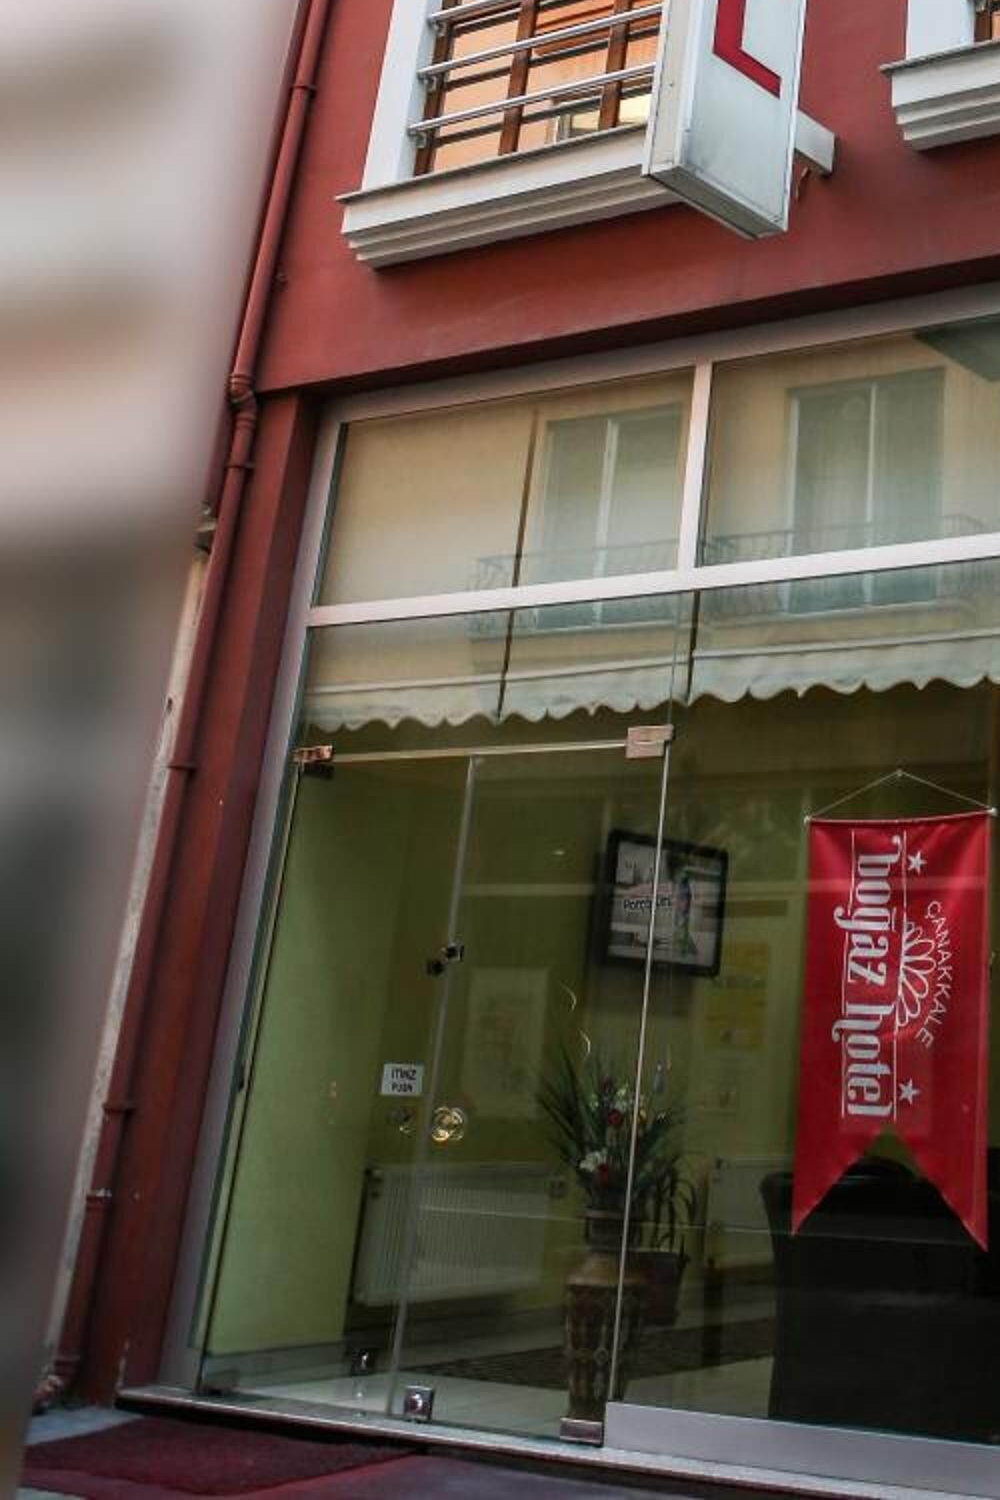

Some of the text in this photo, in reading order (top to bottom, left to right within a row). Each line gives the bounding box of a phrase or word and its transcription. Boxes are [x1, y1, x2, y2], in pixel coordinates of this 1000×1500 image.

[832, 836, 900, 1118] boğaz hotel
[915, 900, 954, 1048] ÇANAKKALE
